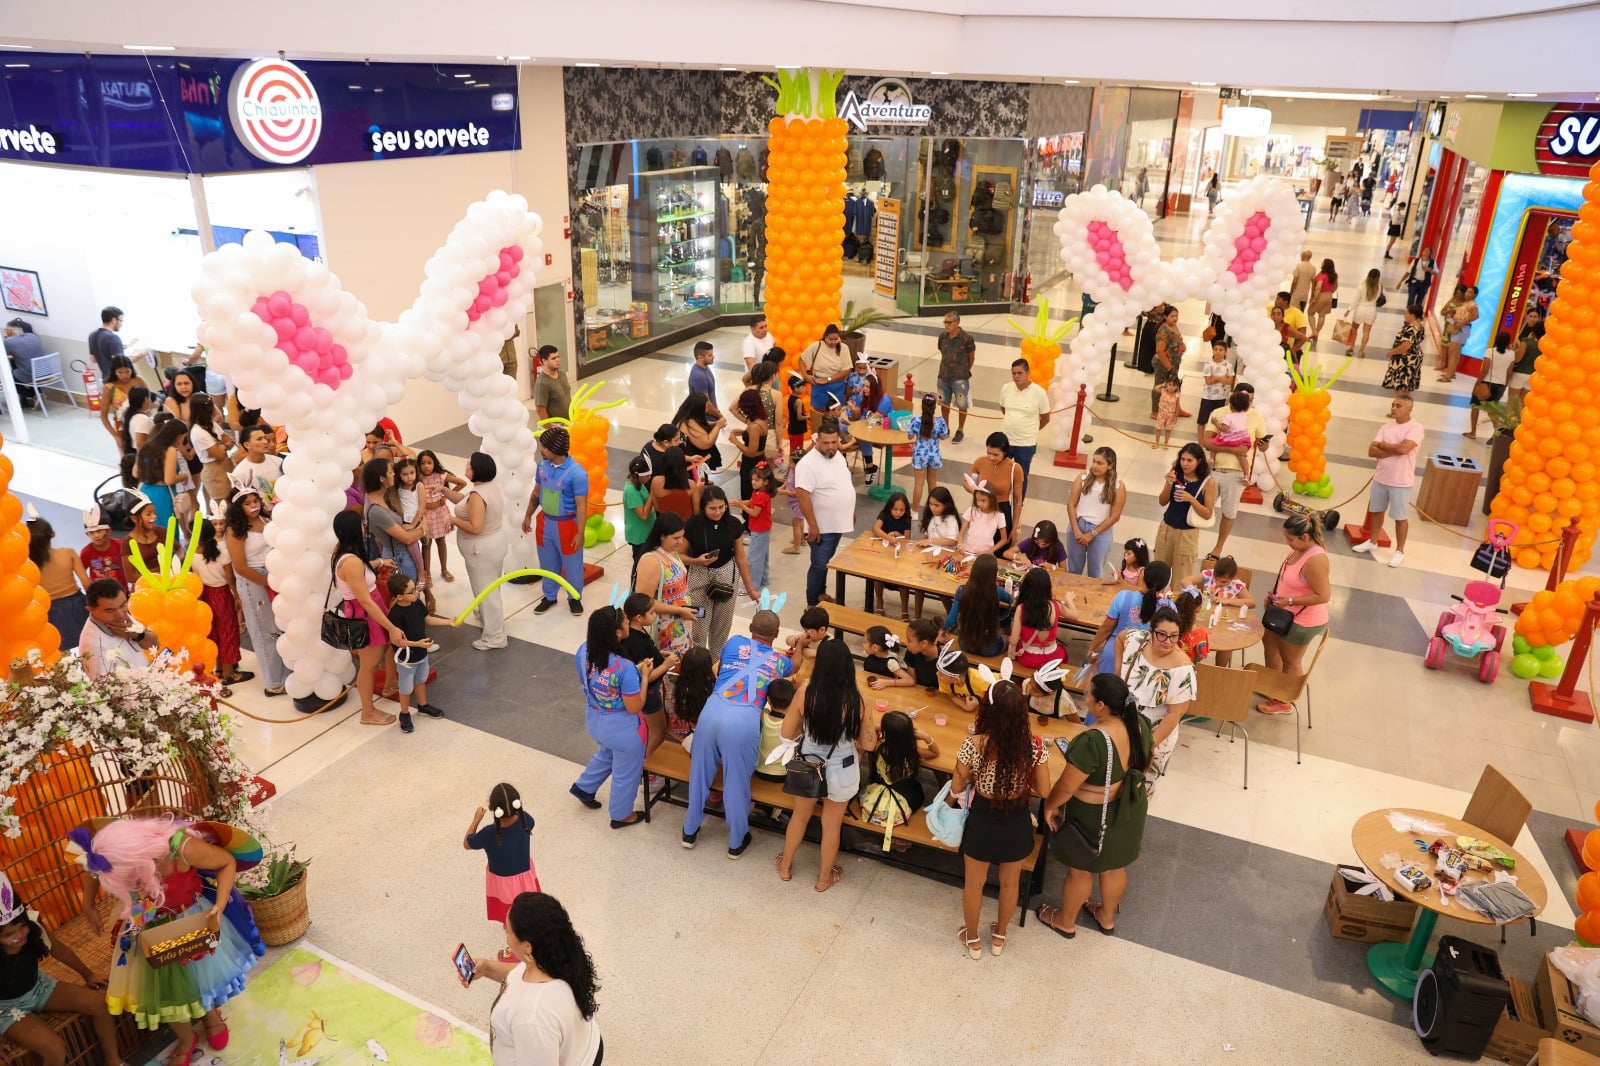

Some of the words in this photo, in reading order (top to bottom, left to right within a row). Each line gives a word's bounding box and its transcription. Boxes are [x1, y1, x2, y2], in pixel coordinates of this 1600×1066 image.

[242, 100, 318, 117] Chiquinho
[840, 91, 930, 131] Adventure
[0, 123, 57, 155] rvete
[371, 130, 411, 153] seu
[414, 121, 490, 150] sorvete
